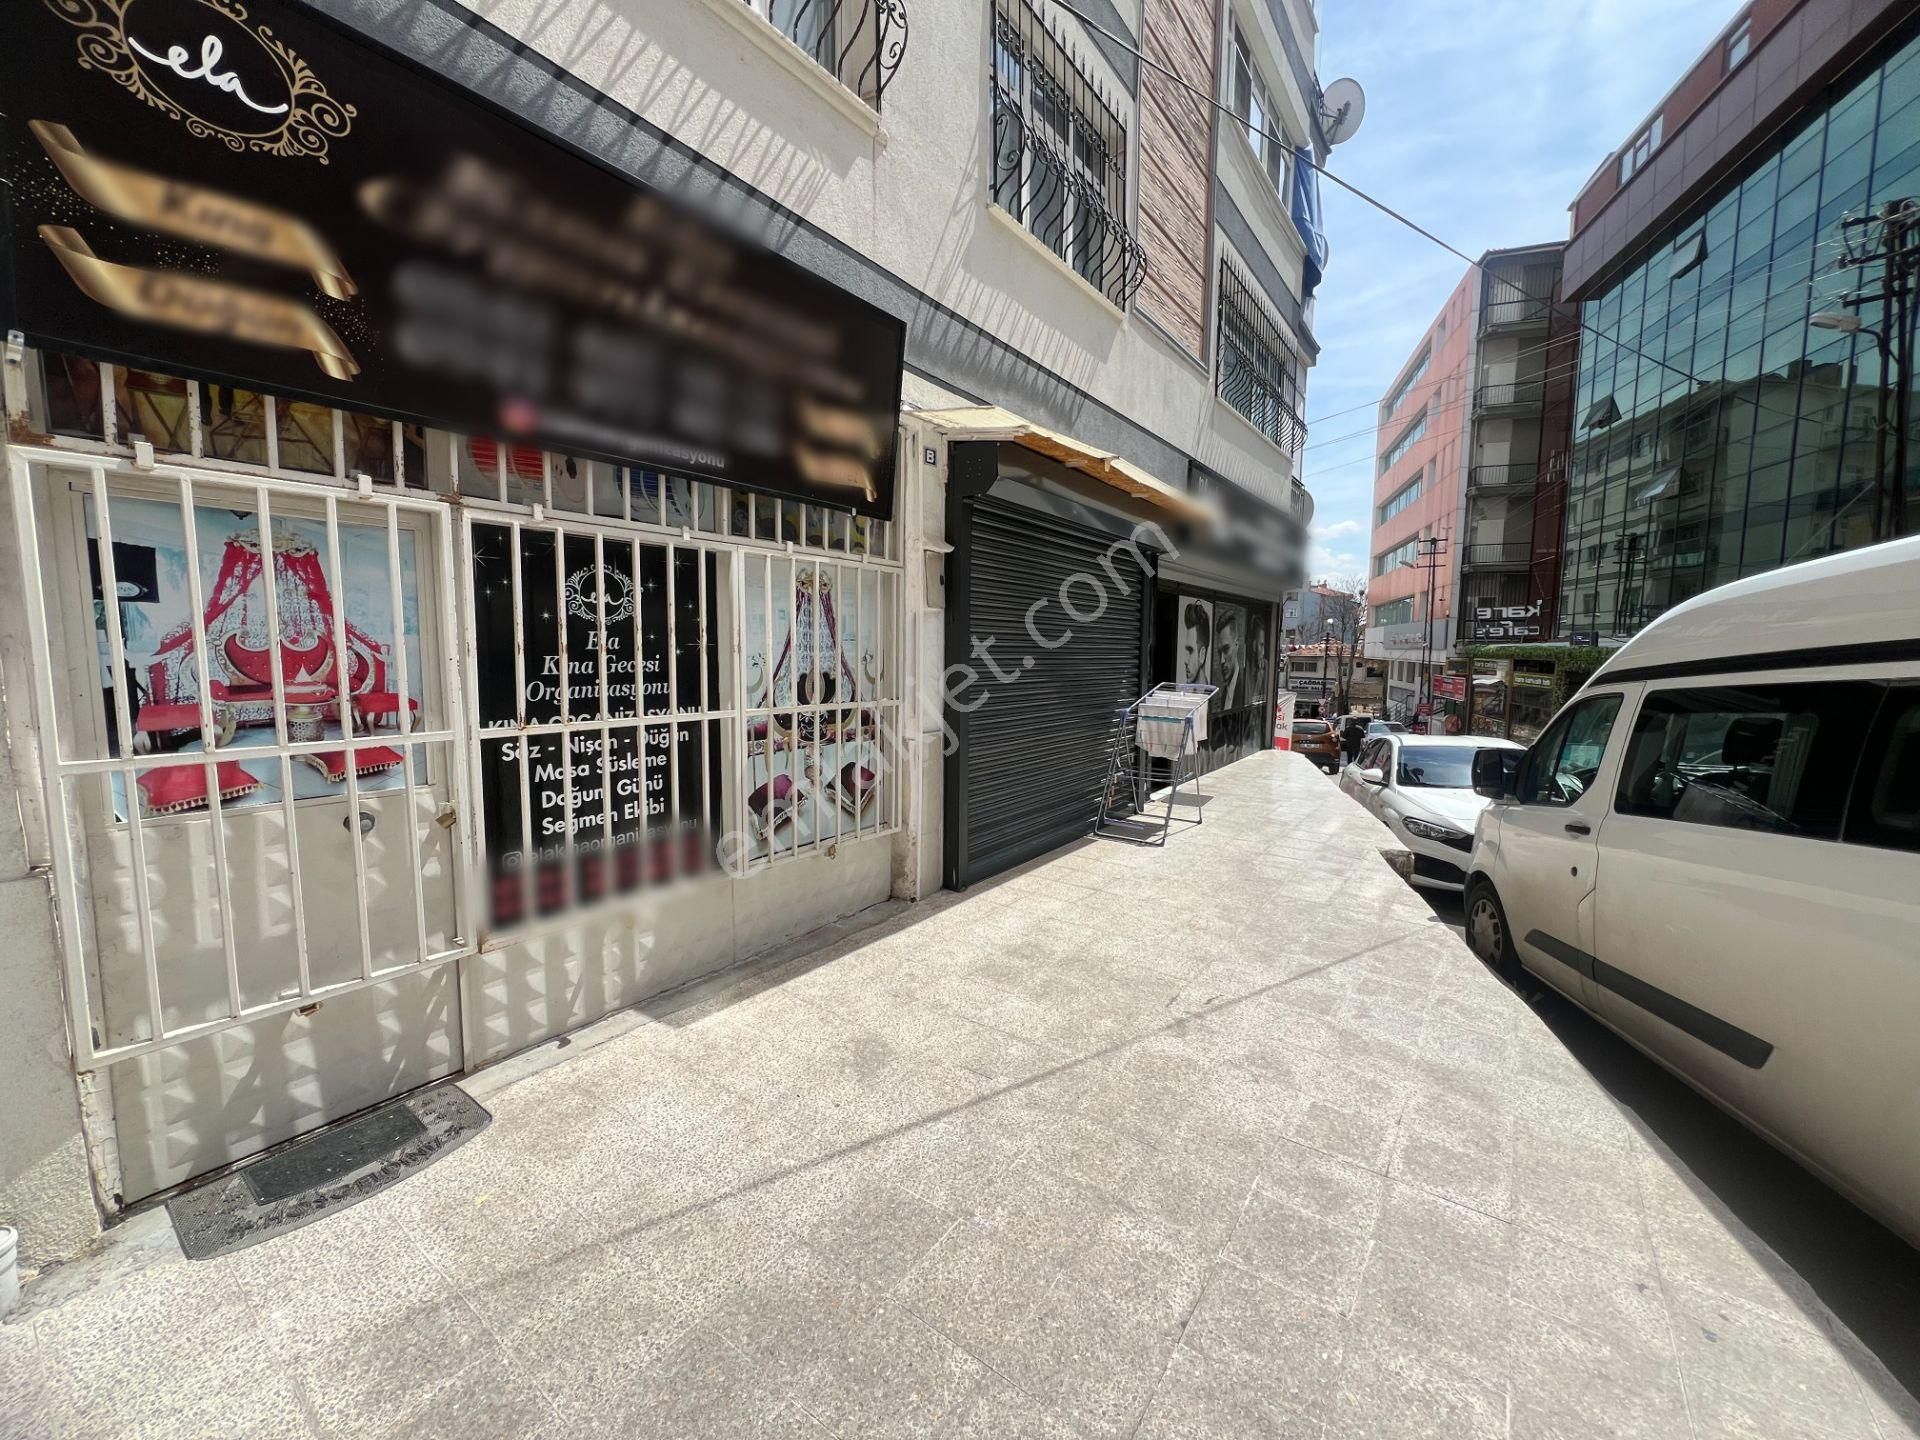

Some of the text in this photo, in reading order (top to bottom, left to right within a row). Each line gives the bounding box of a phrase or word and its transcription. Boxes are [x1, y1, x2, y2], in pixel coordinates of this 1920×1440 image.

[128, 35, 289, 114] ela
[580, 585, 624, 605] ea
[540, 655, 593, 675] Kna
[526, 679, 671, 705] Organiasyonu
[644, 728, 689, 748] üğn
[534, 763, 590, 783] Masa
